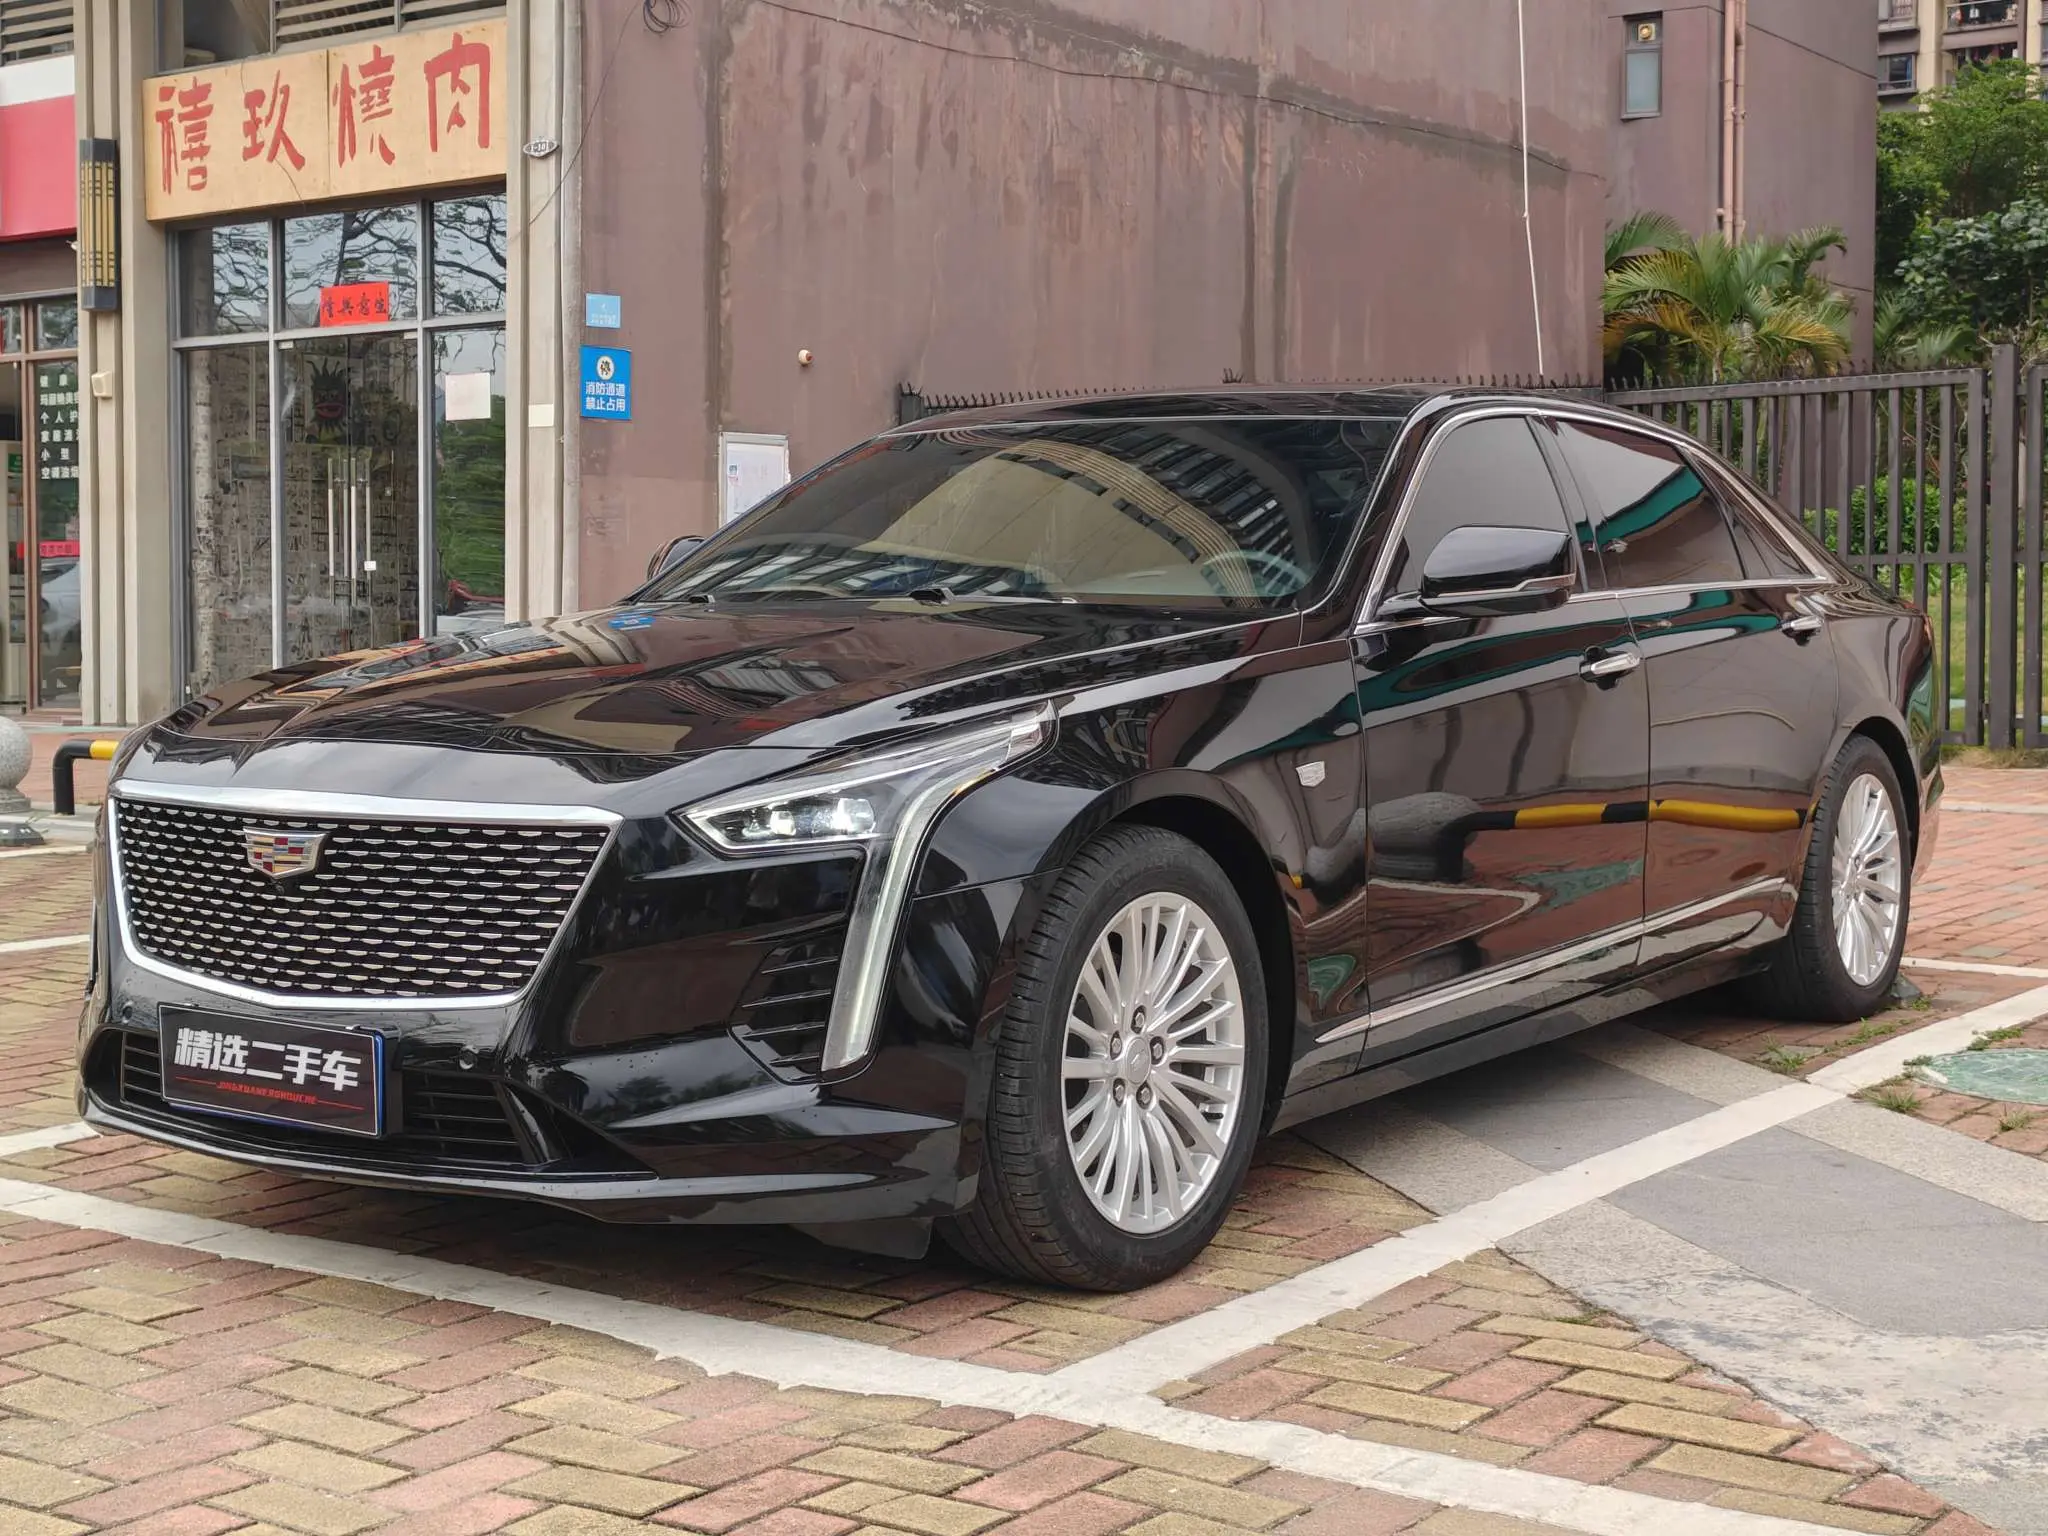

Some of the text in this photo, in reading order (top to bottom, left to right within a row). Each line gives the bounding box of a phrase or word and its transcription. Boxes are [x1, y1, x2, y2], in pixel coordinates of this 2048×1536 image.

[585, 381, 625, 397] 消防通道
[585, 396, 625, 412] 禁止占用
[174, 1027, 362, 1091] 精选二手车
